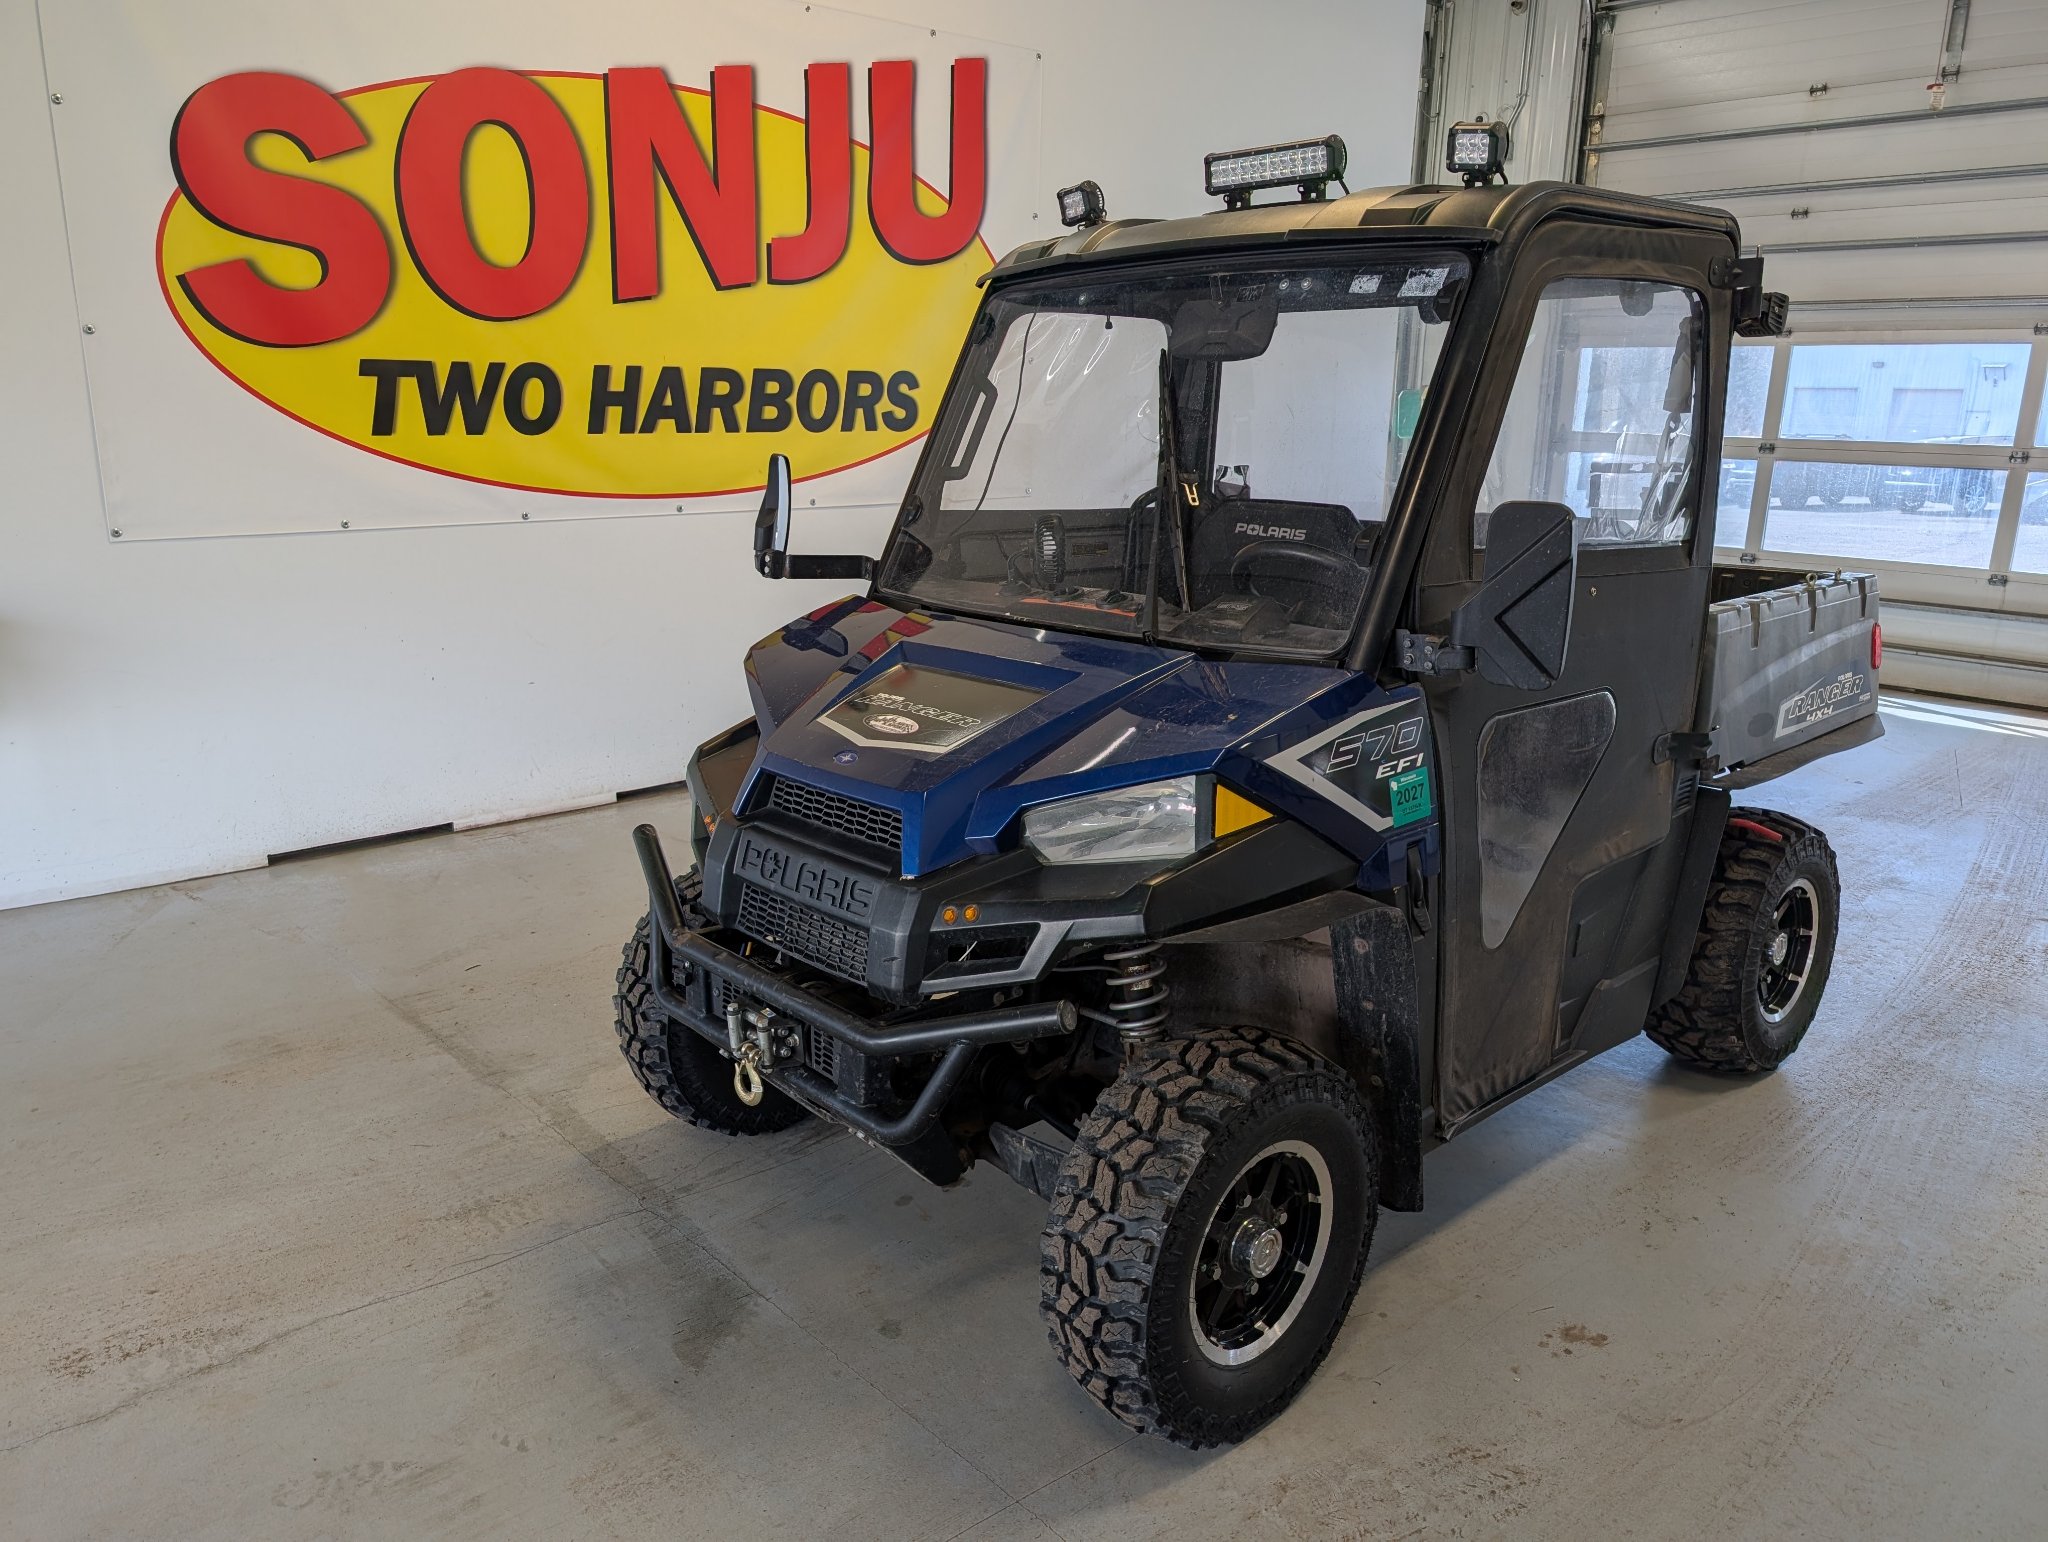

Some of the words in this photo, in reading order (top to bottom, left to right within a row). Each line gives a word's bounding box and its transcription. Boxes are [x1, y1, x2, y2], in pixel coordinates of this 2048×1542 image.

[170, 57, 988, 348] SONJU
[357, 358, 563, 437] TWO
[587, 363, 921, 436] HARBORS
[1234, 522, 1307, 541] POLARIS
[1788, 674, 1864, 719] RANGER
[1325, 716, 1424, 774] 570
[1375, 752, 1425, 780] EFI
[1396, 782, 1424, 806] 2027
[740, 839, 873, 918] POLARIS
